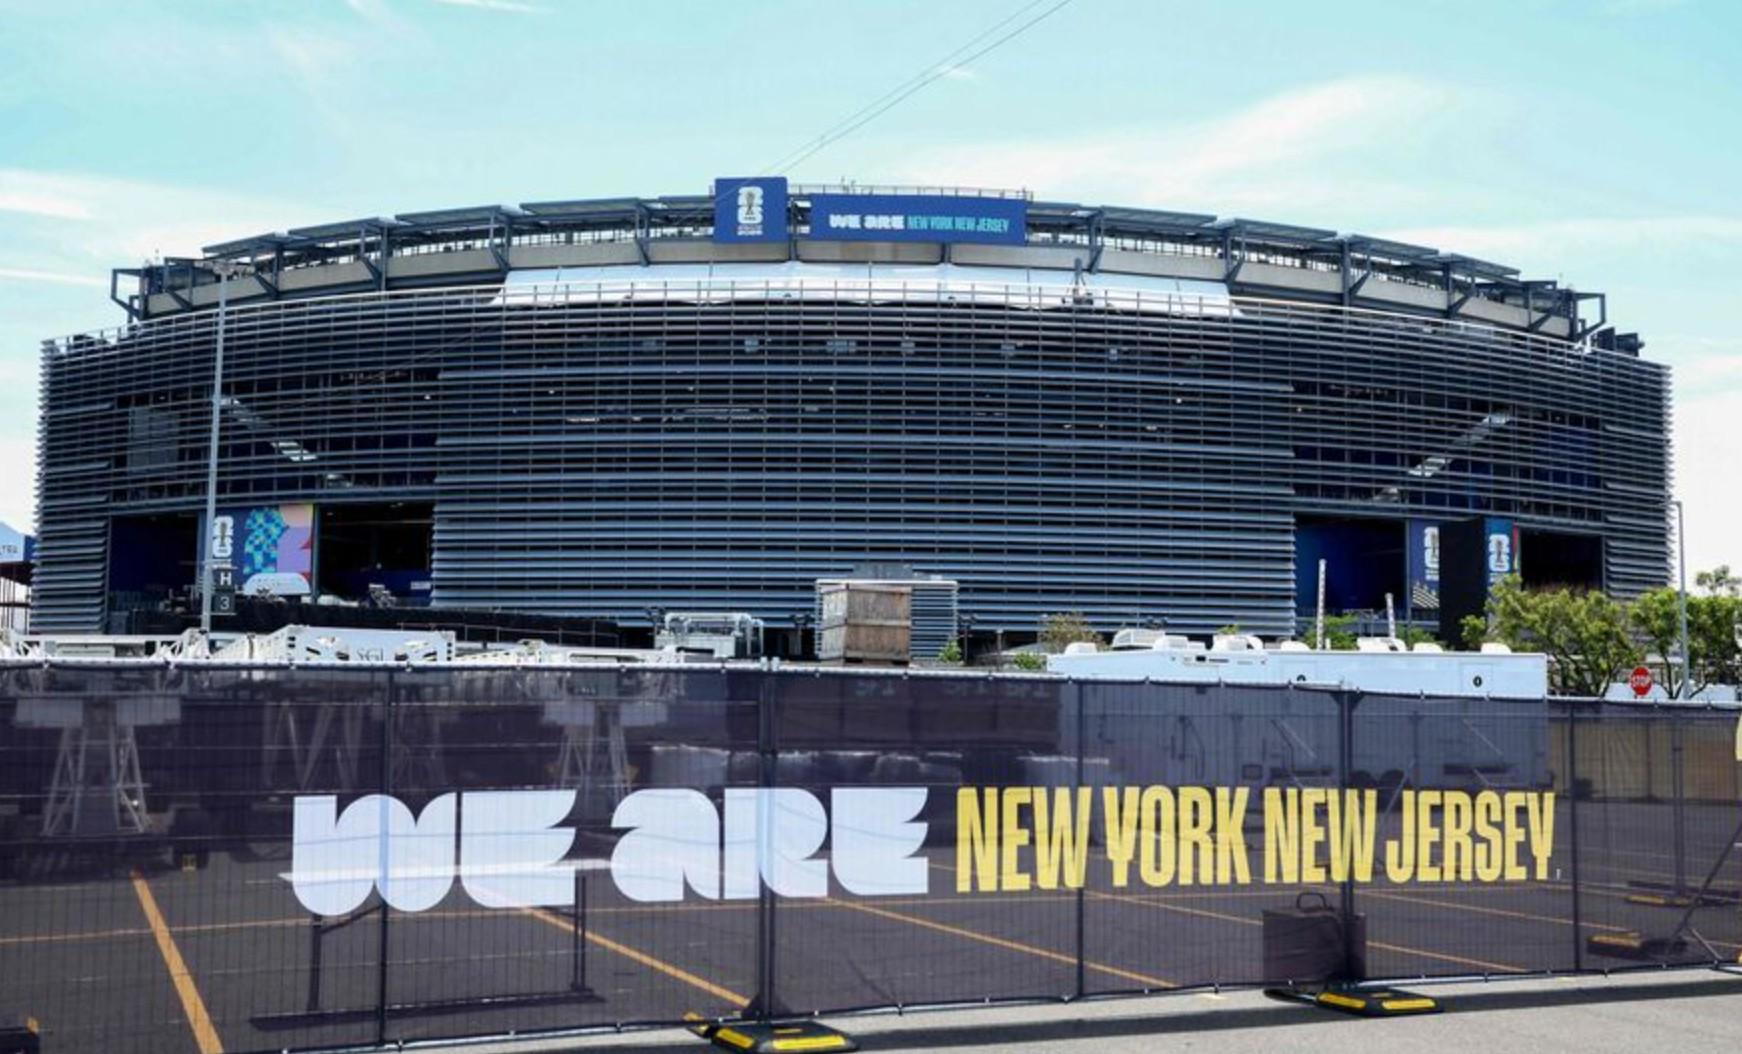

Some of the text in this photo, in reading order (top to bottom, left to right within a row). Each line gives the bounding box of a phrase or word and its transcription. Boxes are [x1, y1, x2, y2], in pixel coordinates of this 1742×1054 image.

[829, 214, 861, 229] WE
[907, 216, 928, 230] NEW
[930, 217, 954, 230] YORK
[955, 217, 976, 231] NEW
[977, 218, 1009, 233] JERSEY
[220, 572, 232, 586] H
[220, 597, 230, 610] 3
[292, 789, 577, 916] WE
[956, 786, 1092, 893] NEW
[1103, 785, 1251, 887] YORK
[1264, 787, 1378, 884] NEW
[1386, 790, 1556, 883] JERSEY
